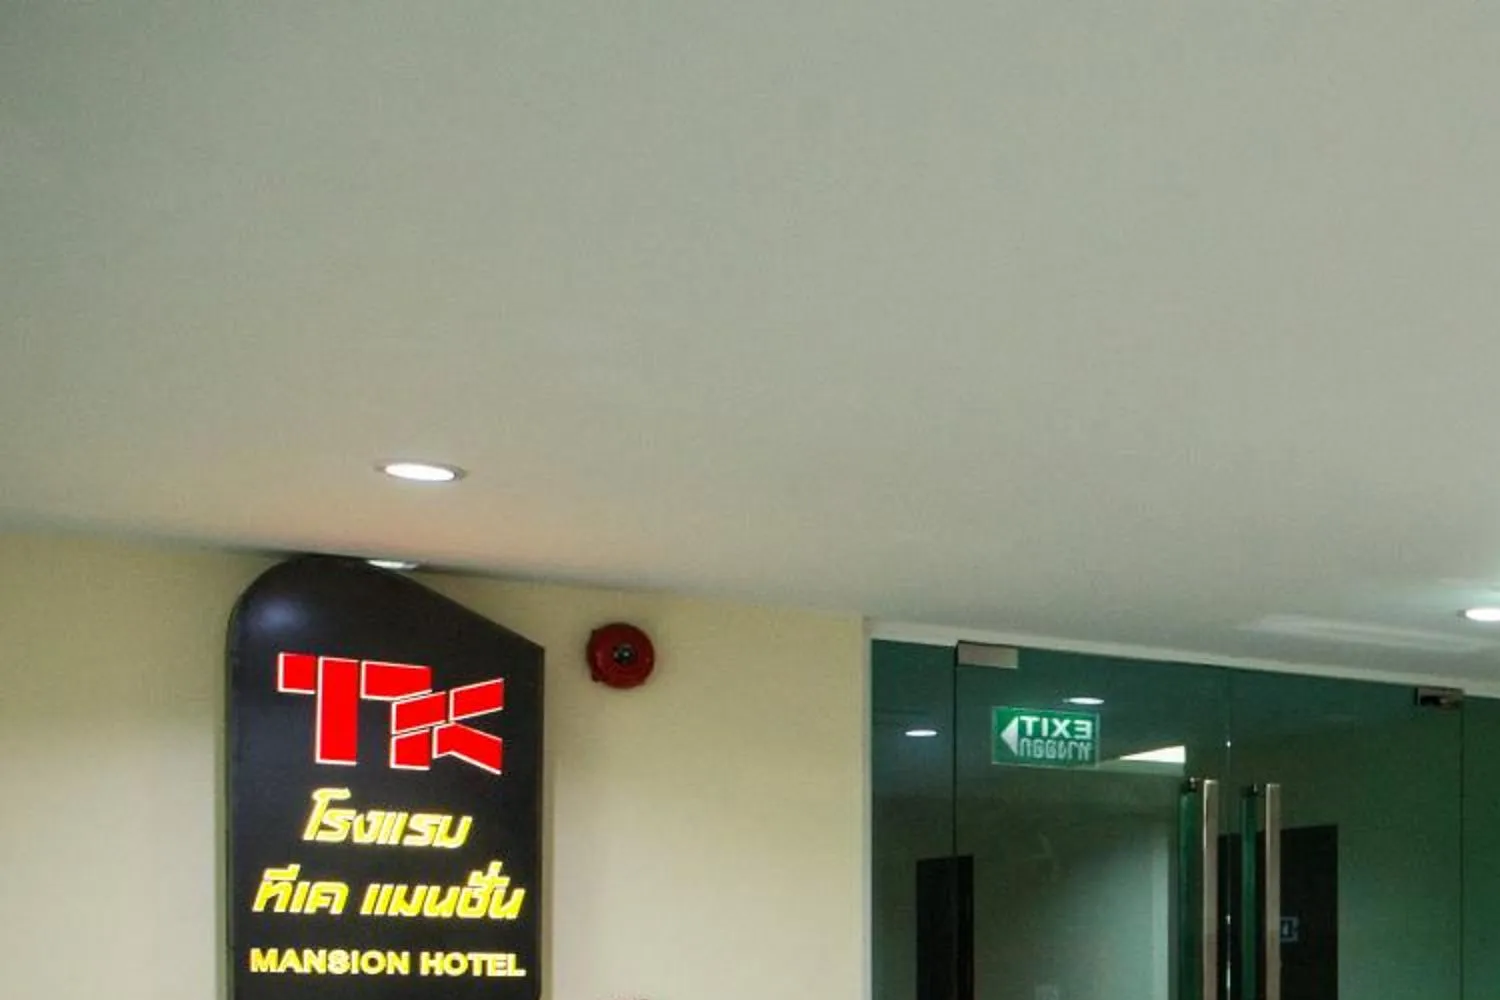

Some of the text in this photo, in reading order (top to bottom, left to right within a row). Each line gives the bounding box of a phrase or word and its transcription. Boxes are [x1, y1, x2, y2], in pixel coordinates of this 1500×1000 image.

[277, 652, 504, 775] TK
[303, 787, 473, 849] โรงแรม
[252, 860, 526, 920] ทีเค แมนชั่น
[249, 947, 527, 977] MANSION HOTEL
